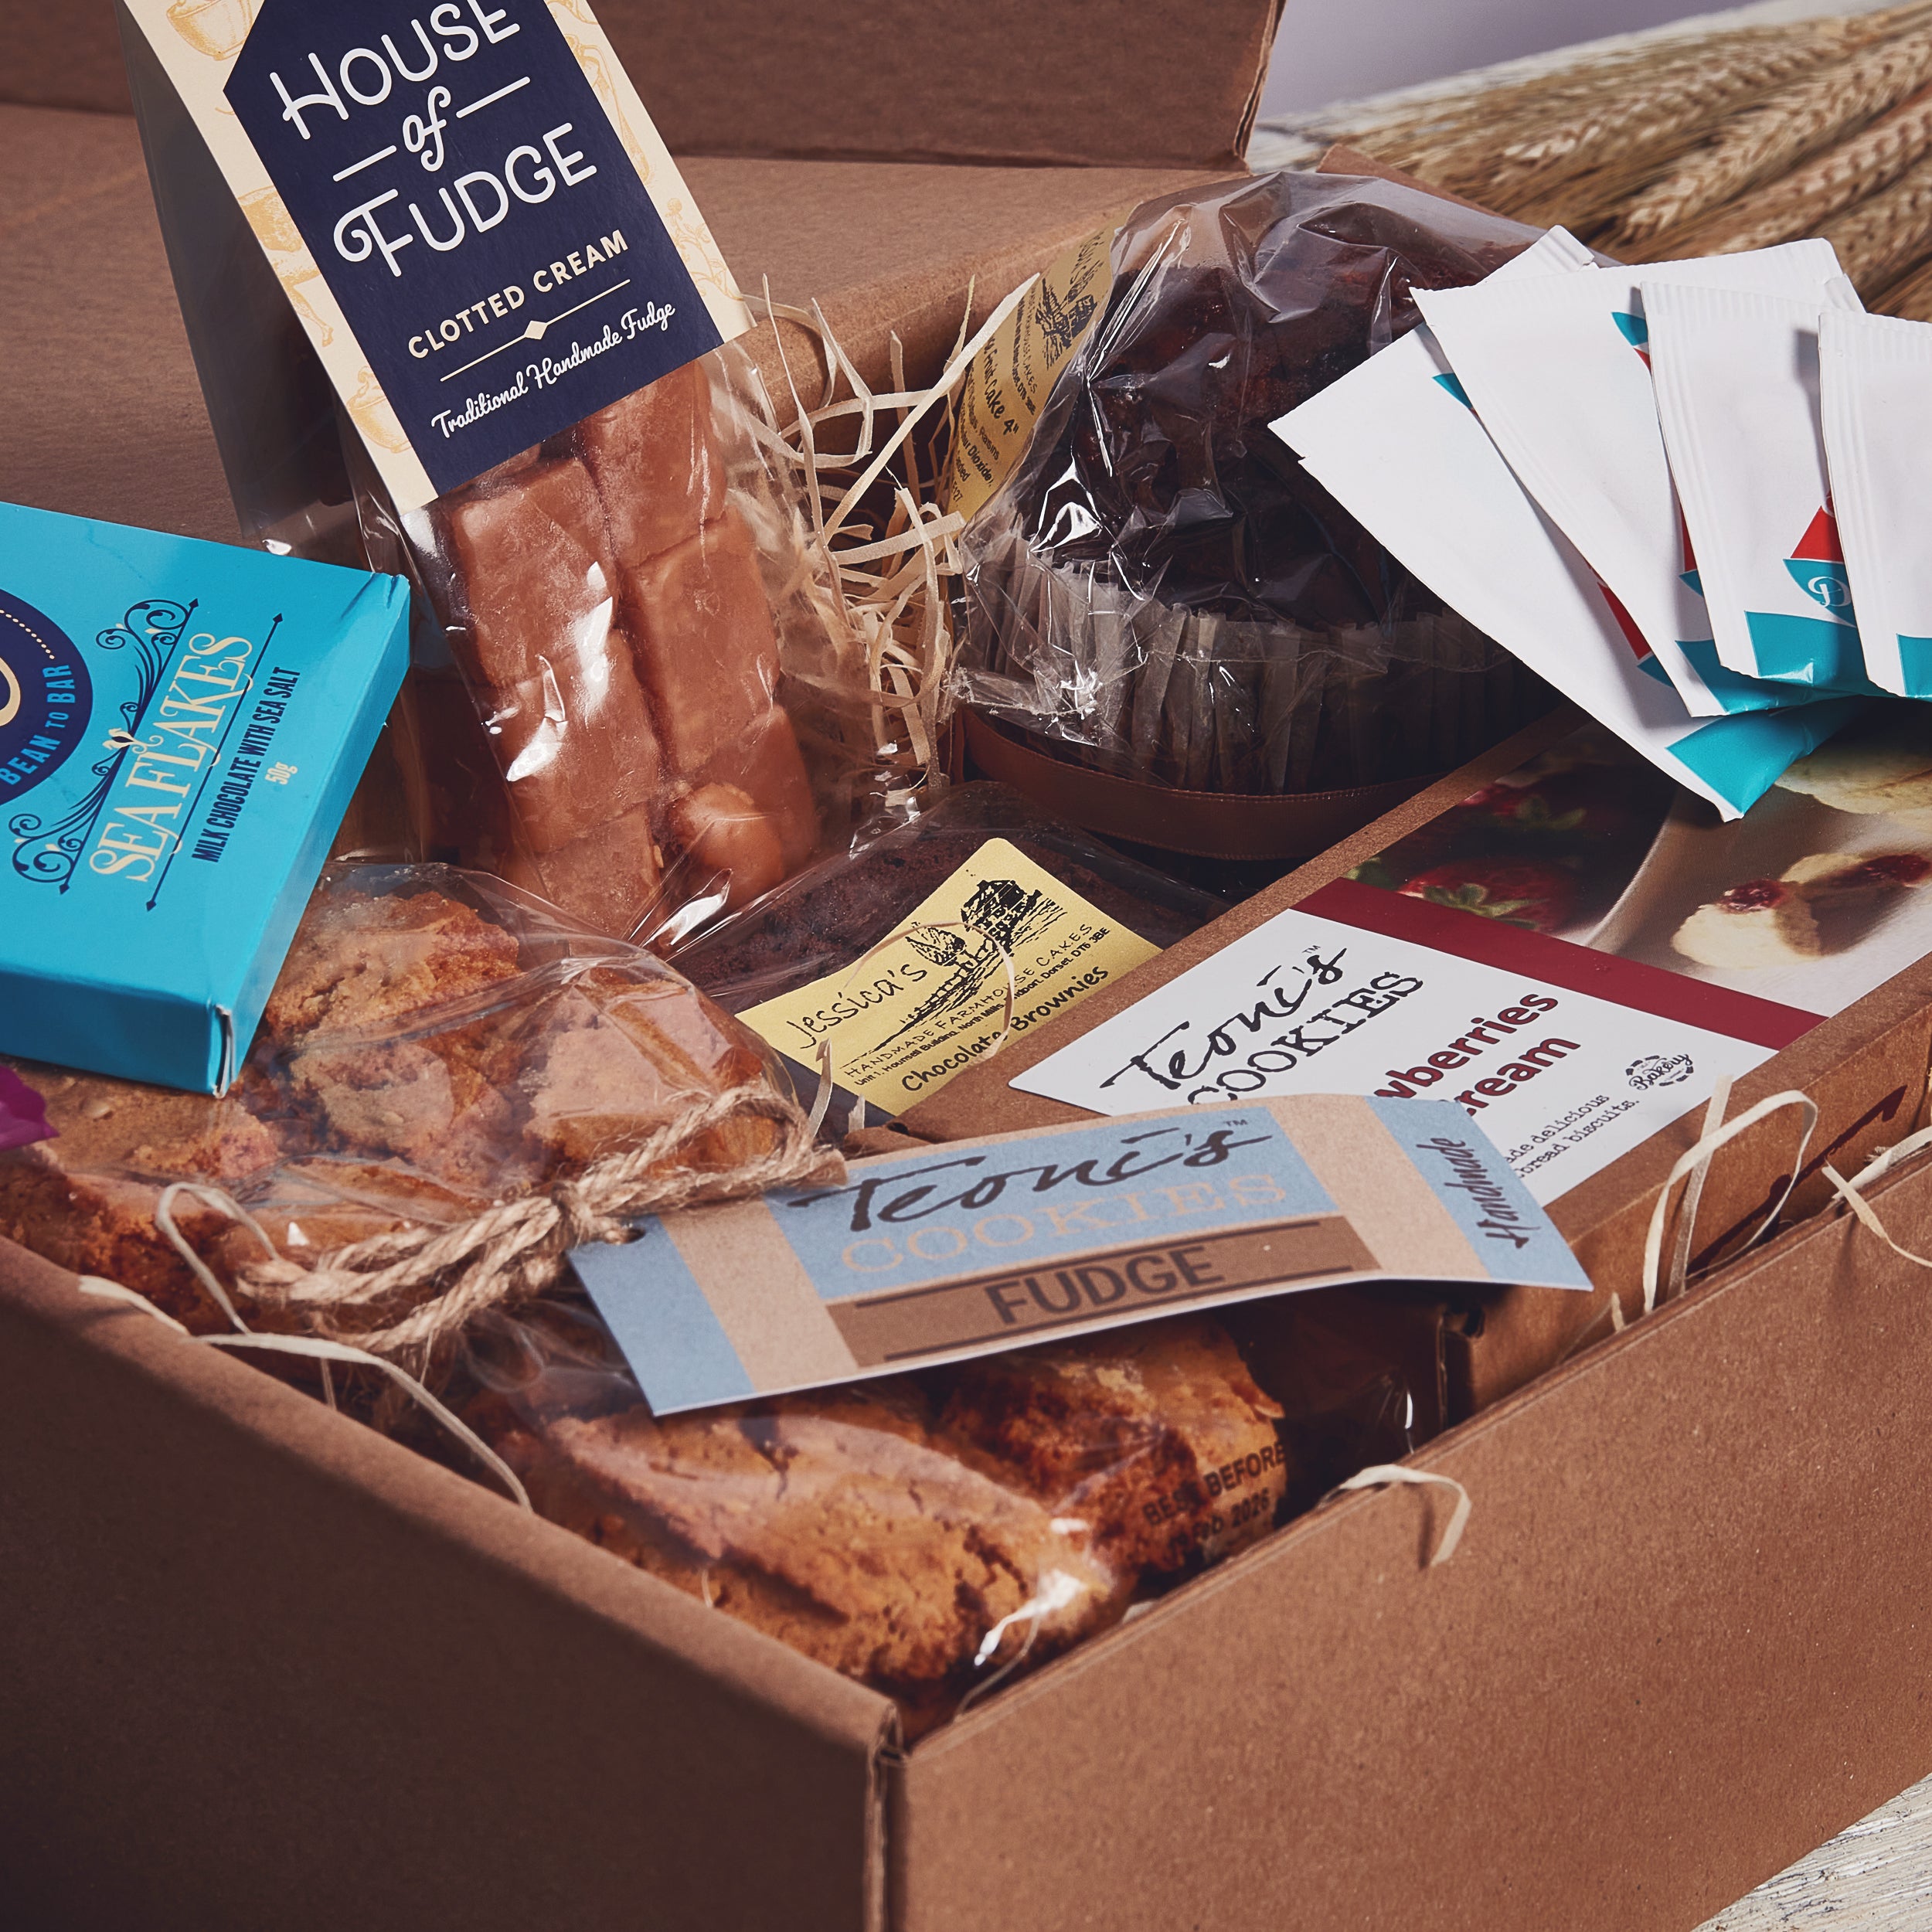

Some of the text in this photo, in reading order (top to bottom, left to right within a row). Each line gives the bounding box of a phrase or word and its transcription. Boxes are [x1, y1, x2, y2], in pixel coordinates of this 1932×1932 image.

[269, 0, 520, 139] HOUSE
[403, 86, 451, 172] of
[333, 122, 597, 277] FUDGE
[408, 230, 628, 359] CLOTTED CREAM
[430, 301, 675, 438] Traditional Handmade Fudge
[985, 379, 1005, 419] Cake
[42, 665, 76, 703] BAR
[45, 712, 70, 728] TO
[0, 735, 61, 785] BEAN
[192, 666, 301, 863] MILK CHOCOLATE WITH SEA SALT
[264, 761, 298, 785] 50g
[787, 964, 927, 1049] Jessica's
[845, 1029, 934, 1077] HANDMADE
[1036, 924, 1092, 966] CAKES
[957, 1015, 984, 1031] North
[1071, 943, 1091, 957] DT6
[1009, 966, 1108, 1031] Brownies
[1100, 947, 1348, 1090] Teoni's
[1454, 1038, 1581, 1117] ream
[1629, 1054, 1692, 1090] Bakery
[1515, 1100, 1640, 1179] bread biscuits.
[1532, 1094, 1610, 1144] delicious
[787, 1127, 1273, 1232] Teoni's
[1416, 1138, 1541, 1249] Handmade
[842, 1173, 1287, 1273] COOKIES
[984, 1244, 1224, 1326] FUDGE
[1203, 1441, 1286, 1498] BEFORE
